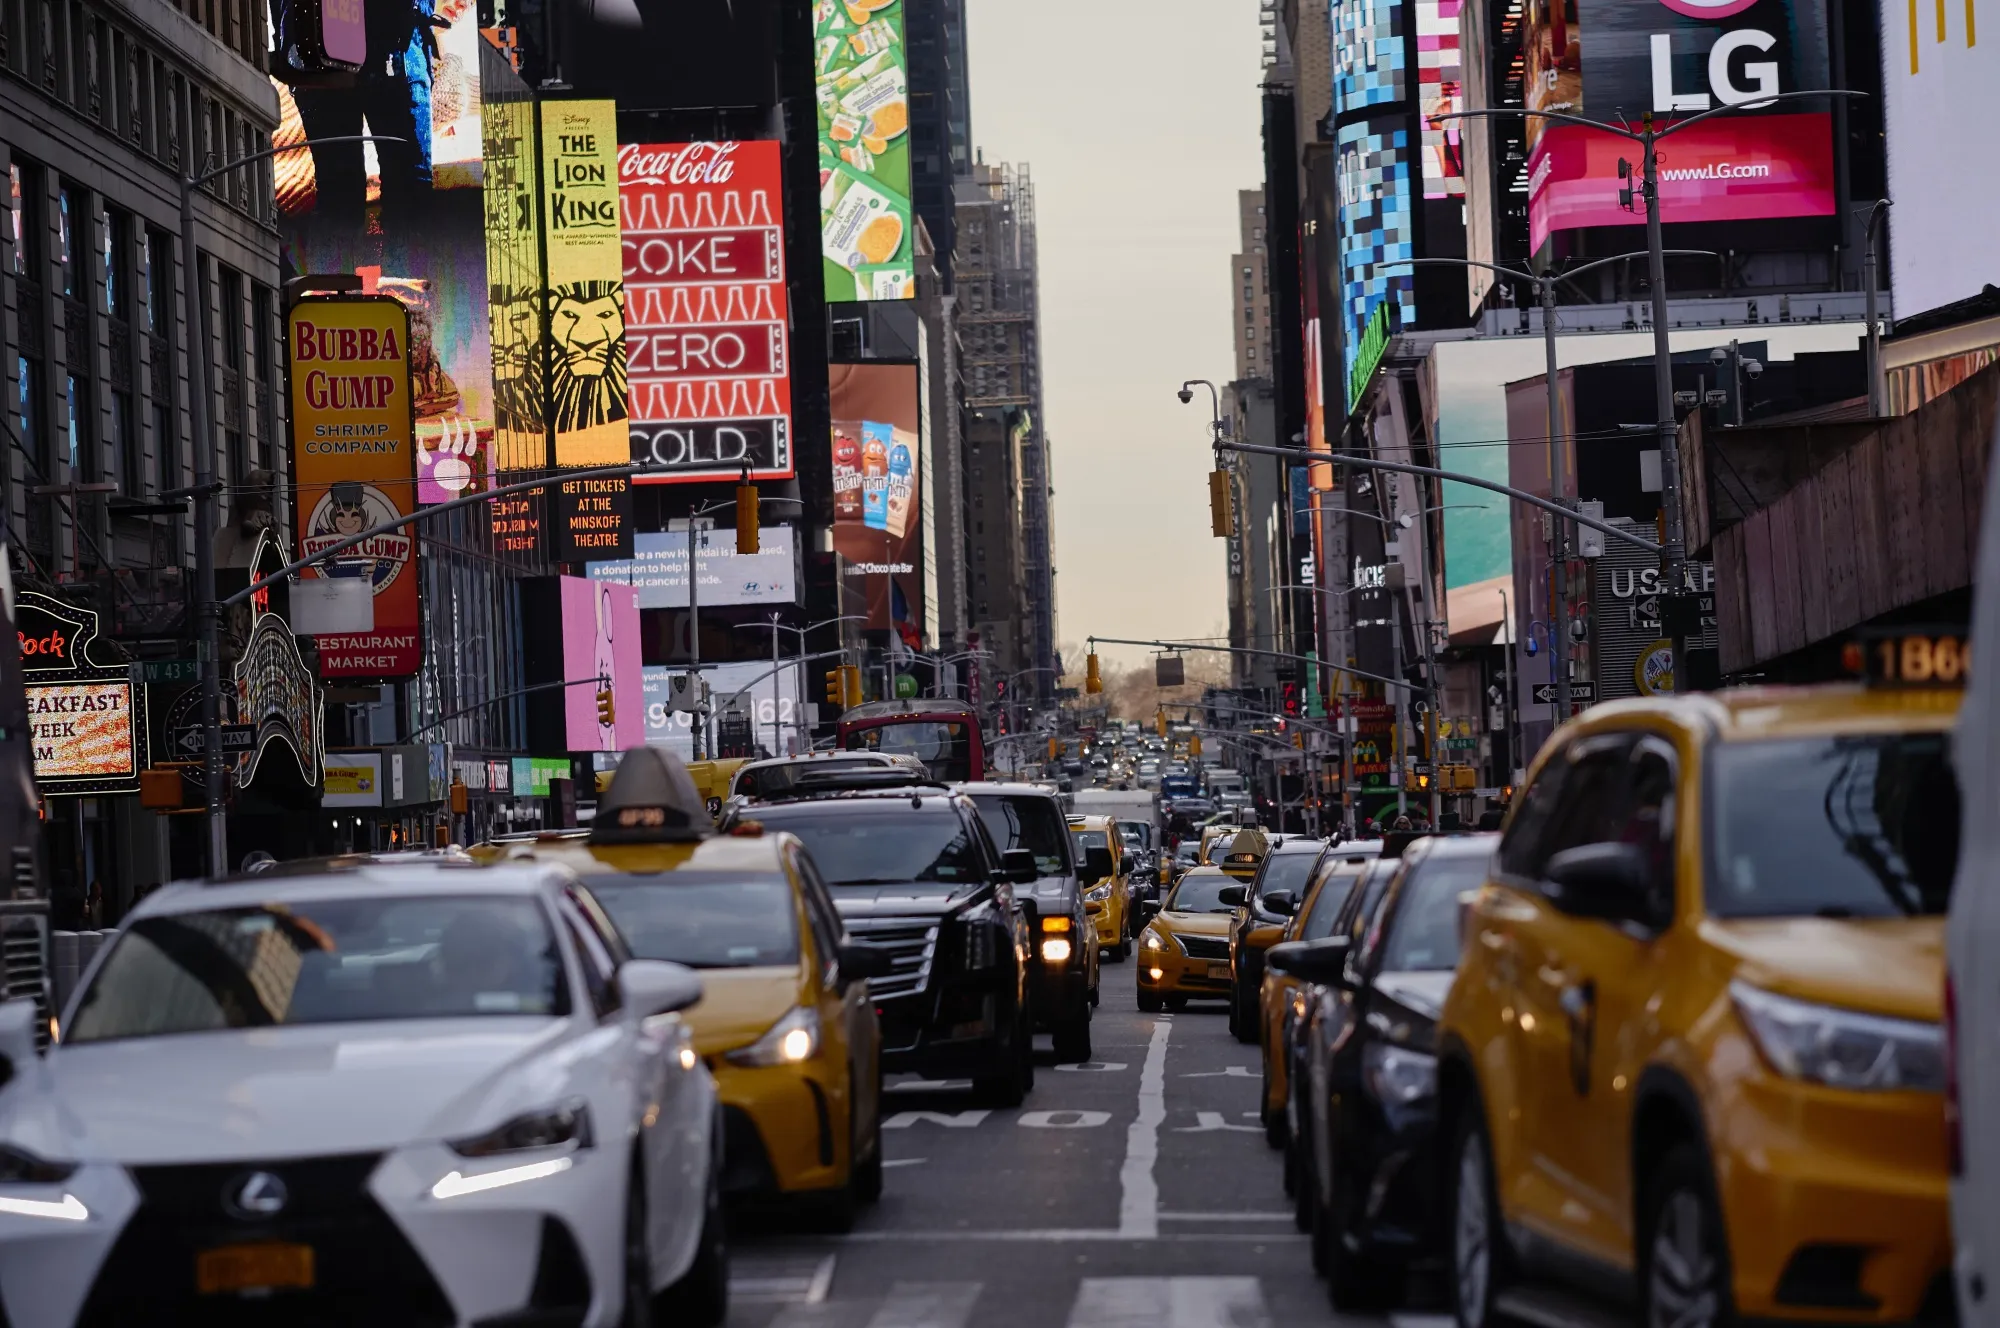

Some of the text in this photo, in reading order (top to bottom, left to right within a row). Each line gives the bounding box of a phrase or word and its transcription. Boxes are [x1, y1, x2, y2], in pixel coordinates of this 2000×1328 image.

[1650, 29, 1780, 112] LG
[871, 78, 895, 96] SPIRALS
[562, 115, 590, 125] Disney
[559, 134, 597, 153] THE
[553, 158, 605, 189] LION
[1661, 163, 1769, 182] www.LG.com
[552, 193, 615, 229] KING
[829, 223, 848, 248] VEGGIE
[845, 196, 864, 227] SPIRALS
[294, 320, 402, 362] BUBBA
[625, 333, 746, 373] ZERO
[305, 369, 396, 411] GUMP
[314, 423, 389, 437] SHRIMP
[305, 440, 399, 454] COMPANY
[630, 427, 747, 465] COLD
[562, 479, 626, 494] GET TICKETS
[578, 497, 612, 511] AT THE
[569, 515, 621, 529] MINSKOFF
[574, 533, 619, 547] THEATRE
[362, 537, 409, 559] GUMP
[655, 552, 676, 560] new
[677, 547, 720, 560] Hyndai
[721, 549, 729, 558] is
[731, 546, 786, 558] pased,
[594, 560, 708, 575] a donation to help fiht
[866, 562, 900, 573] Chocoate
[901, 562, 913, 573] Bar
[377, 565, 400, 591] MARKET
[646, 577, 679, 587] cancer
[681, 575, 689, 585] is
[1646, 603, 1660, 615] ON
[314, 635, 416, 651] ESTAURANT
[328, 655, 398, 669] MARKET
[146, 662, 197, 680] W 43 St
[643, 684, 659, 692] ted:
[899, 680, 910, 691] m
[187, 732, 246, 747] ON WAY
[1458, 740, 1467, 748] 44
